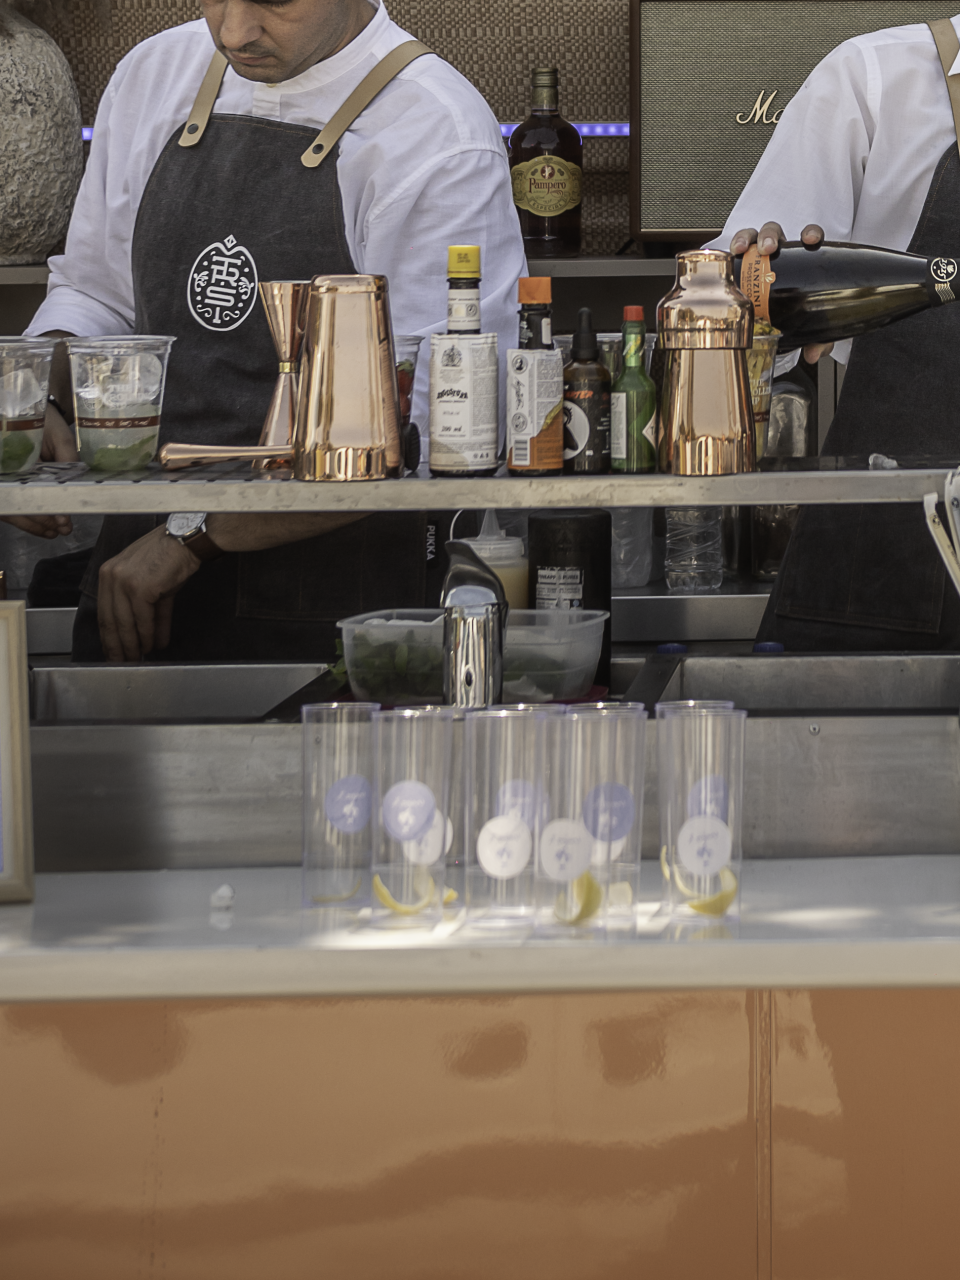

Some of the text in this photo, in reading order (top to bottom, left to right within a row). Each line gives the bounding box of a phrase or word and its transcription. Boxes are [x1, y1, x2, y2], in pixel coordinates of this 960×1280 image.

[528, 177, 567, 195] Pampero
[937, 258, 948, 280] 1915
[426, 524, 436, 561] PUKKA
